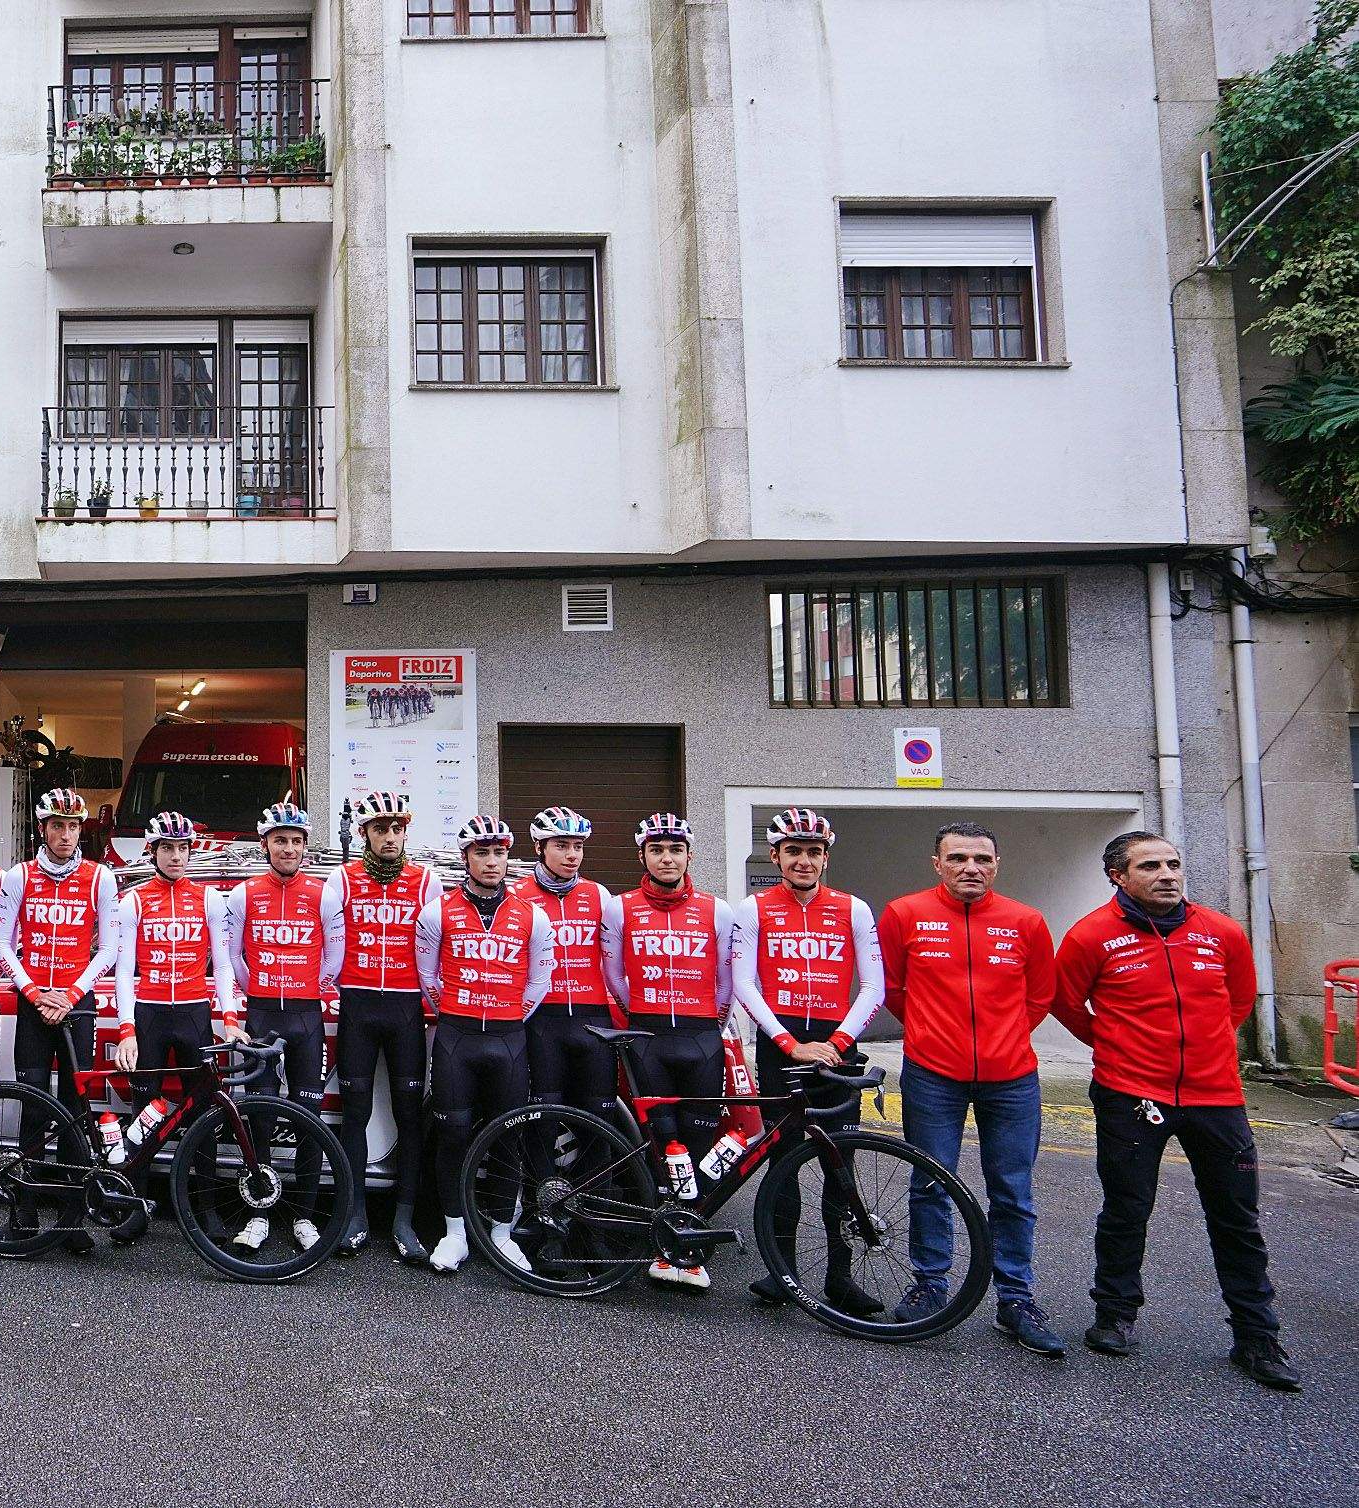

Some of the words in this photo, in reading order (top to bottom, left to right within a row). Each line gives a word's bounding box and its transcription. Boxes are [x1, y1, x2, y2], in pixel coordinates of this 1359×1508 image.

[351, 660, 377, 668] Grupo
[402, 659, 453, 673] FROIZ
[350, 670, 391, 679] Deportivo
[162, 752, 259, 762] Supermercados
[26, 897, 87, 905] supermercados
[351, 898, 416, 906] supermercados
[26, 904, 87, 925] FROIZ
[352, 905, 416, 925] FROIZ
[916, 921, 949, 931] FROIZ
[143, 923, 202, 942] FROIZ
[252, 925, 314, 945] FROIZ
[549, 926, 596, 946] ROIZ
[767, 931, 846, 941] supermercados
[451, 933, 523, 945] supermercados
[1103, 934, 1140, 952] FROIZ
[451, 939, 521, 964] FROIZ
[632, 936, 708, 958] FROIZ
[767, 938, 844, 962] FROIZ
[995, 942, 1012, 951] BH
[0, 957, 17, 980] FROIZ
[566, 985, 593, 993] GALICIA
[670, 996, 700, 1004] GALICIA
[793, 993, 822, 1001] XUNTA
[807, 1001, 838, 1009] GALICIA
[504, 1114, 526, 1129] SWISS
[528, 1111, 542, 1121] DT
[781, 1274, 796, 1289] DT
[793, 1288, 821, 1310] SWISS
